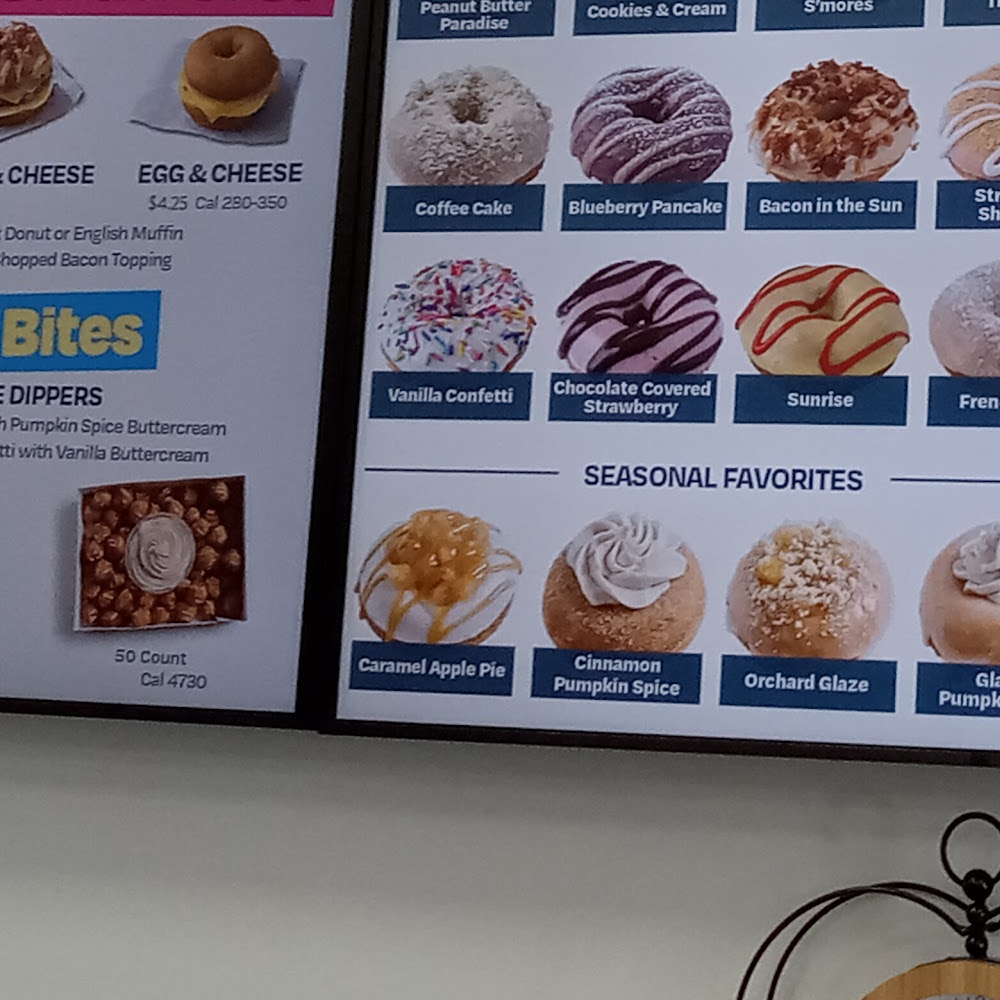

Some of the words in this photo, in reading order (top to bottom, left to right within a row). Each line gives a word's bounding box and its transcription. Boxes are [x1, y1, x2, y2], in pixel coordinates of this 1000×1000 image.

[420, 0, 477, 15] Peanut
[587, 3, 652, 18] Cookies
[672, 1, 727, 17] Cream
[439, 16, 509, 31] Paradise
[8, 165, 95, 184] CHEESE
[138, 163, 185, 183] EGG
[211, 162, 303, 183] CHEESE
[415, 201, 470, 217] Coffee
[472, 201, 513, 216] Cake
[568, 200, 648, 219] Blueberry
[652, 199, 723, 215] Pancake
[759, 199, 813, 213] Bacon
[836, 198, 866, 213] the
[868, 198, 903, 213] Sun
[5, 226, 51, 241] Donut
[73, 225, 128, 245] English
[131, 224, 184, 241] Muffin
[61, 252, 108, 267] Bacon
[111, 252, 172, 271] Topping
[2, 306, 144, 358] Bites
[10, 385, 104, 406] DIPPERS
[388, 386, 441, 403] Vanilla
[445, 387, 514, 404] Confetti
[553, 380, 638, 396] Chocolate
[642, 381, 712, 397] Covered
[583, 398, 679, 418] Strawberry
[787, 392, 855, 408] Sunrise
[128, 419, 227, 437] Buttercream
[111, 446, 209, 463] Buttercream
[584, 465, 717, 488] SEASONAL
[723, 467, 863, 491] FAVORITES
[140, 650, 187, 666] Count
[574, 655, 661, 673] Cinnamon
[358, 657, 426, 675] Caramel
[429, 659, 476, 679] Apple
[479, 661, 506, 678] Pie
[553, 676, 629, 696] Pumpkin
[632, 679, 681, 698] Spice
[744, 672, 816, 691] Orchard
[819, 674, 869, 692] Glaze
